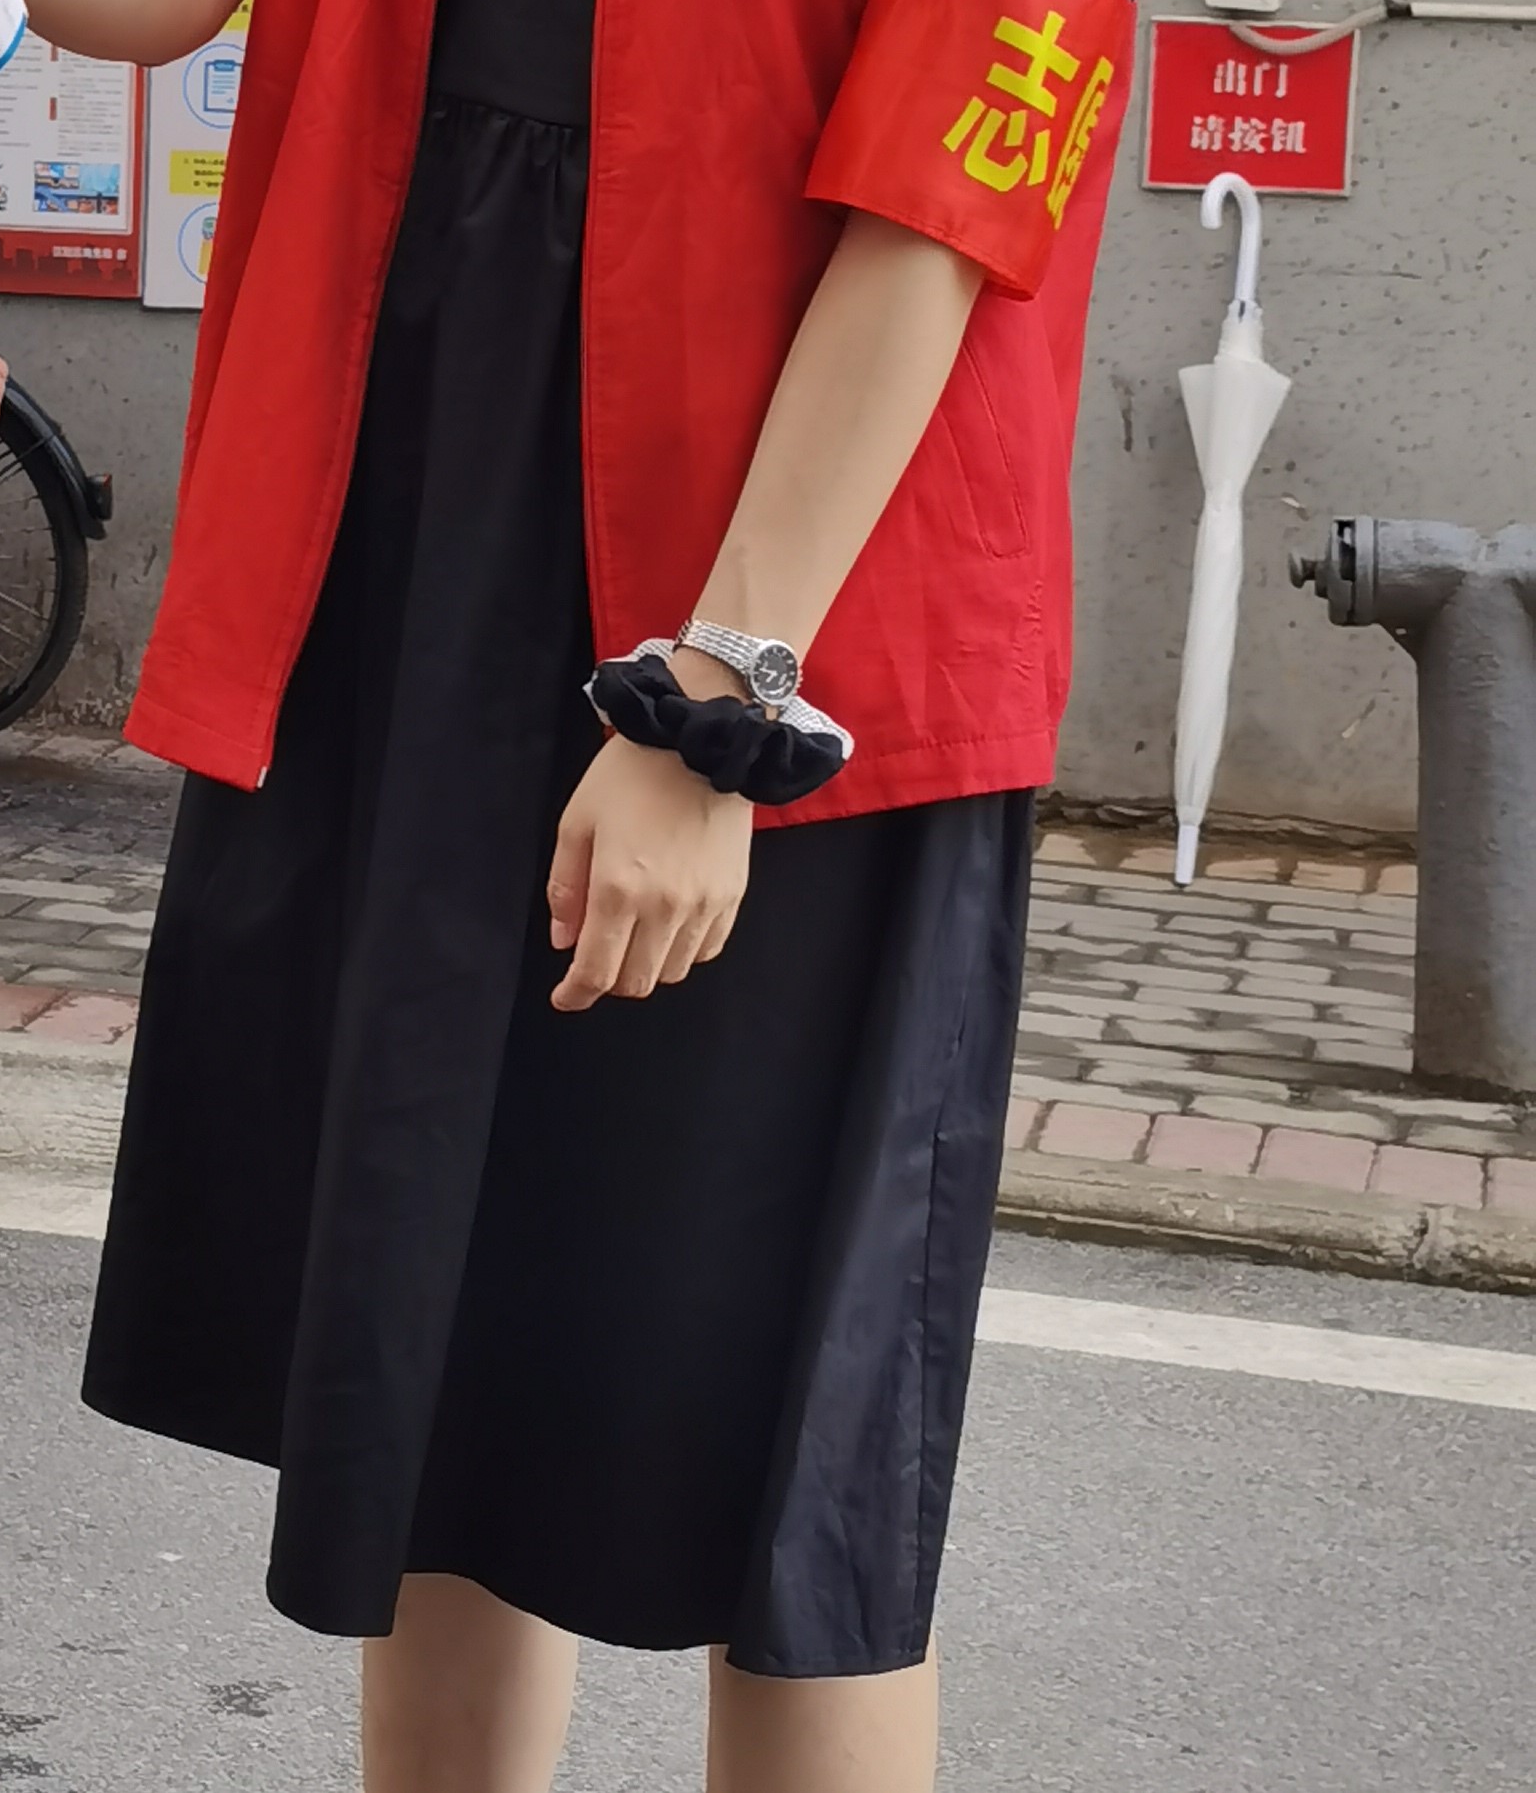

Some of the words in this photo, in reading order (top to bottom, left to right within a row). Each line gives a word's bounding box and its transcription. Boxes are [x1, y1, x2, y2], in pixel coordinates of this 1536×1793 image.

[1213, 59, 1289, 98] 出门
[1190, 114, 1308, 154] 请按钮
